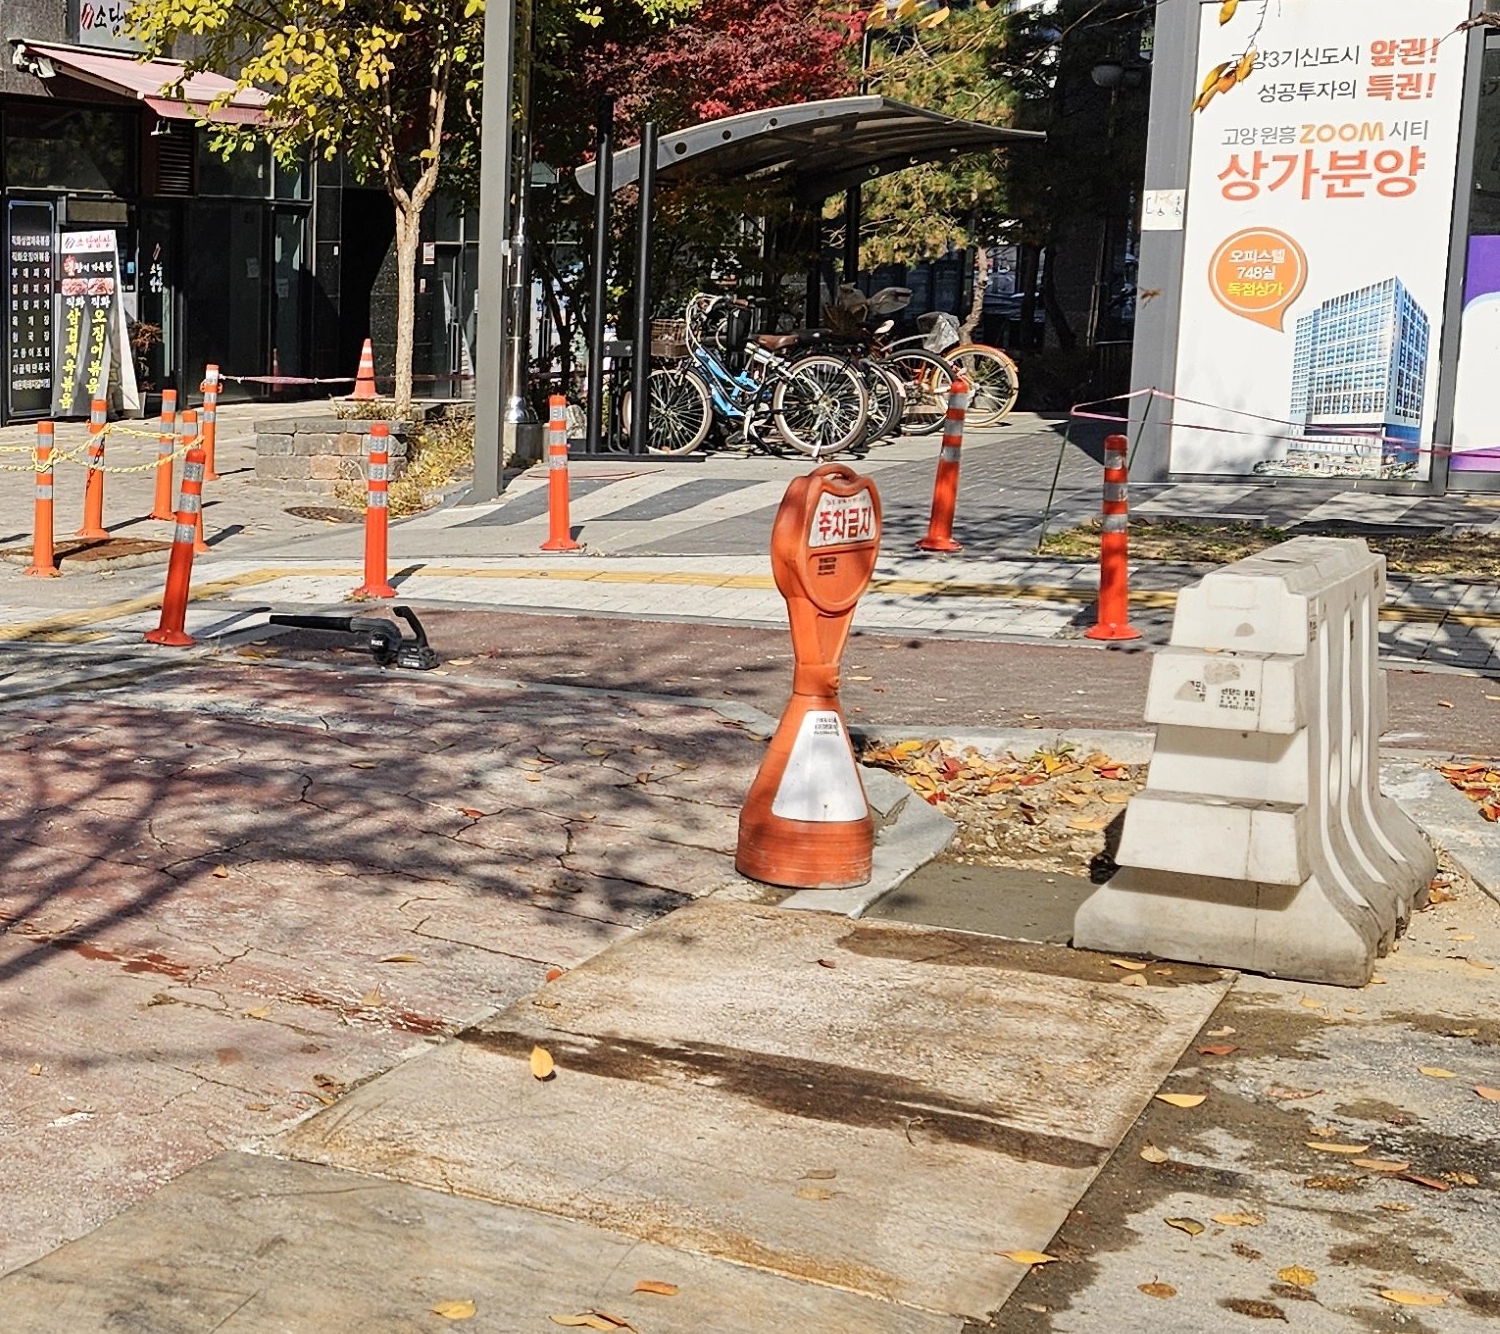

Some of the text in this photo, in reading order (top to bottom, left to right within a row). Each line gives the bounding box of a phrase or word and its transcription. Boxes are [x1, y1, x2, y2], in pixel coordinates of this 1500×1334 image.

[1370, 37, 1441, 68] 앞권!
[1257, 72, 1437, 104] 성공투자의 특권!
[1221, 119, 1430, 146] 고양 원흥 ZOOM 시티
[1217, 144, 1427, 202] 상가분양
[1228, 248, 1286, 263] 오피스텔
[1237, 265, 1277, 280] 748실
[1227, 282, 1284, 297] 독점상가
[58, 309, 81, 409] 삼겹제육볶음
[85, 309, 108, 394] 오징어볶음
[818, 506, 872, 541] 주차금지
